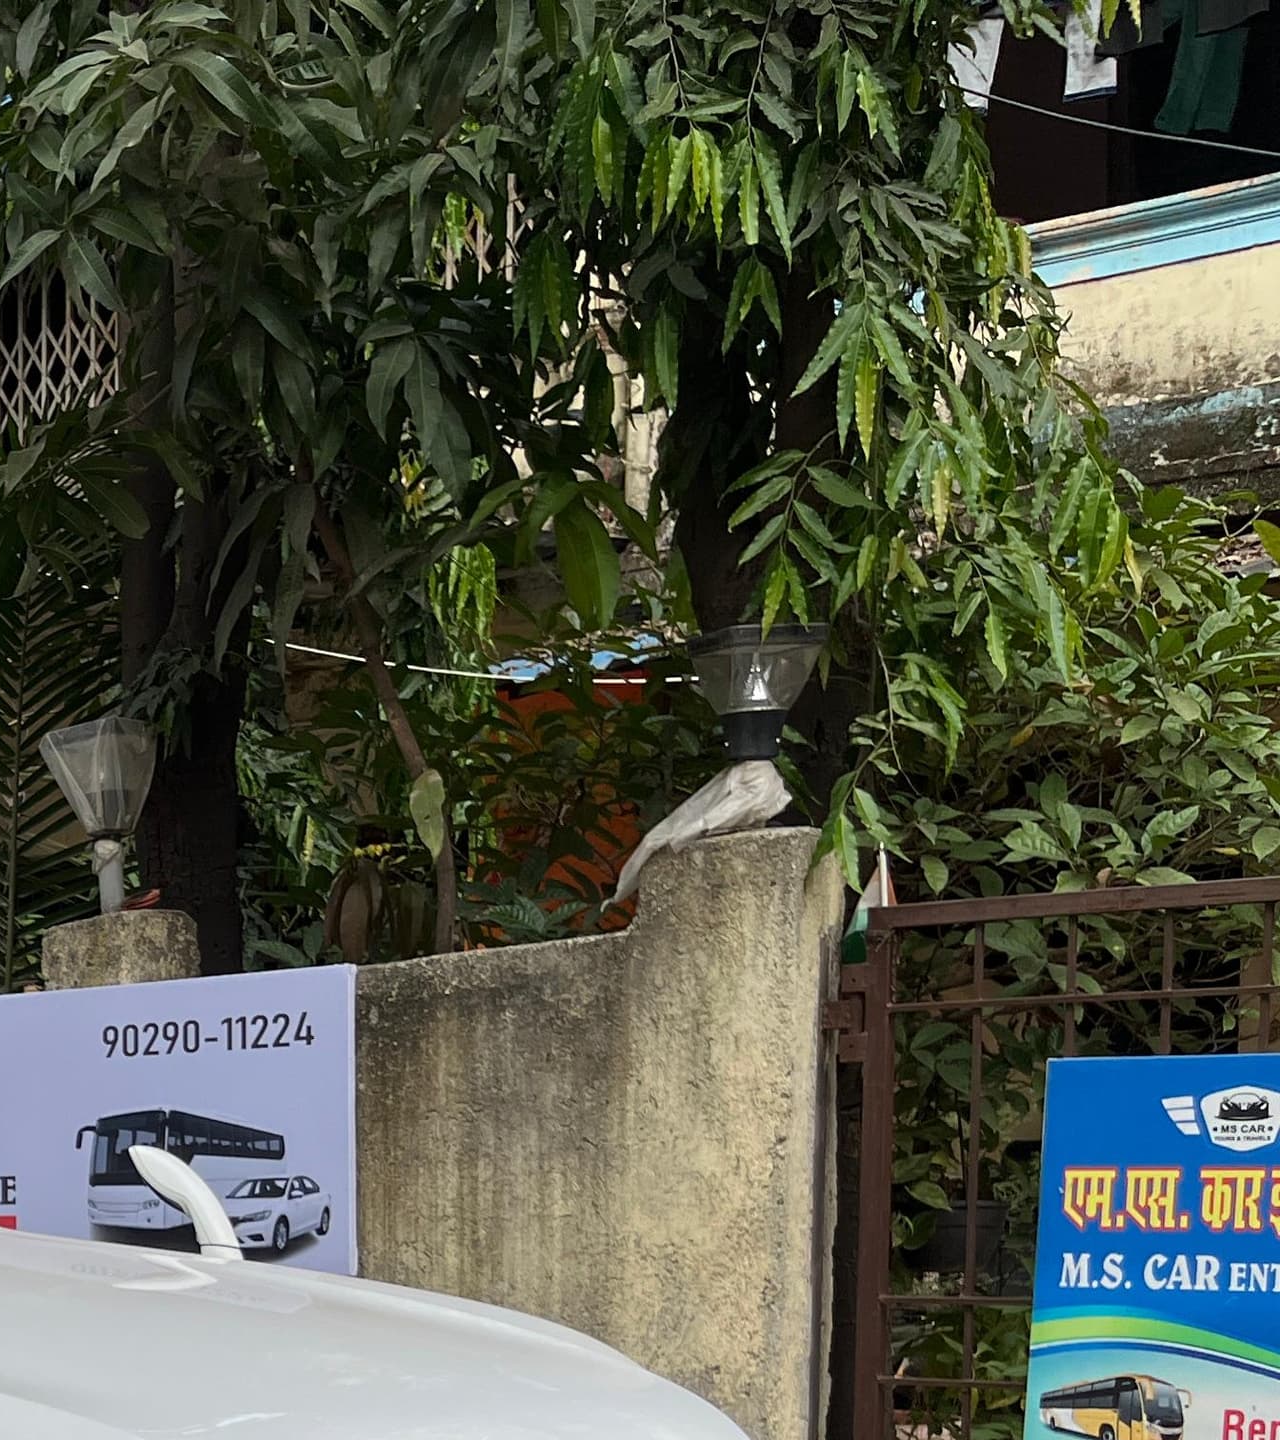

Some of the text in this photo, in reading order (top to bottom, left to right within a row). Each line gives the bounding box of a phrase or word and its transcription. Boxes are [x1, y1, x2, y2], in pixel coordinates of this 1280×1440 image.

[101, 1011, 315, 1059] 90290-11224
[1240, 1124, 1266, 1134] CAR
[1200, 1166, 1267, 1232] कार
[1058, 1252, 1280, 1294] M.S. CAR ENT
